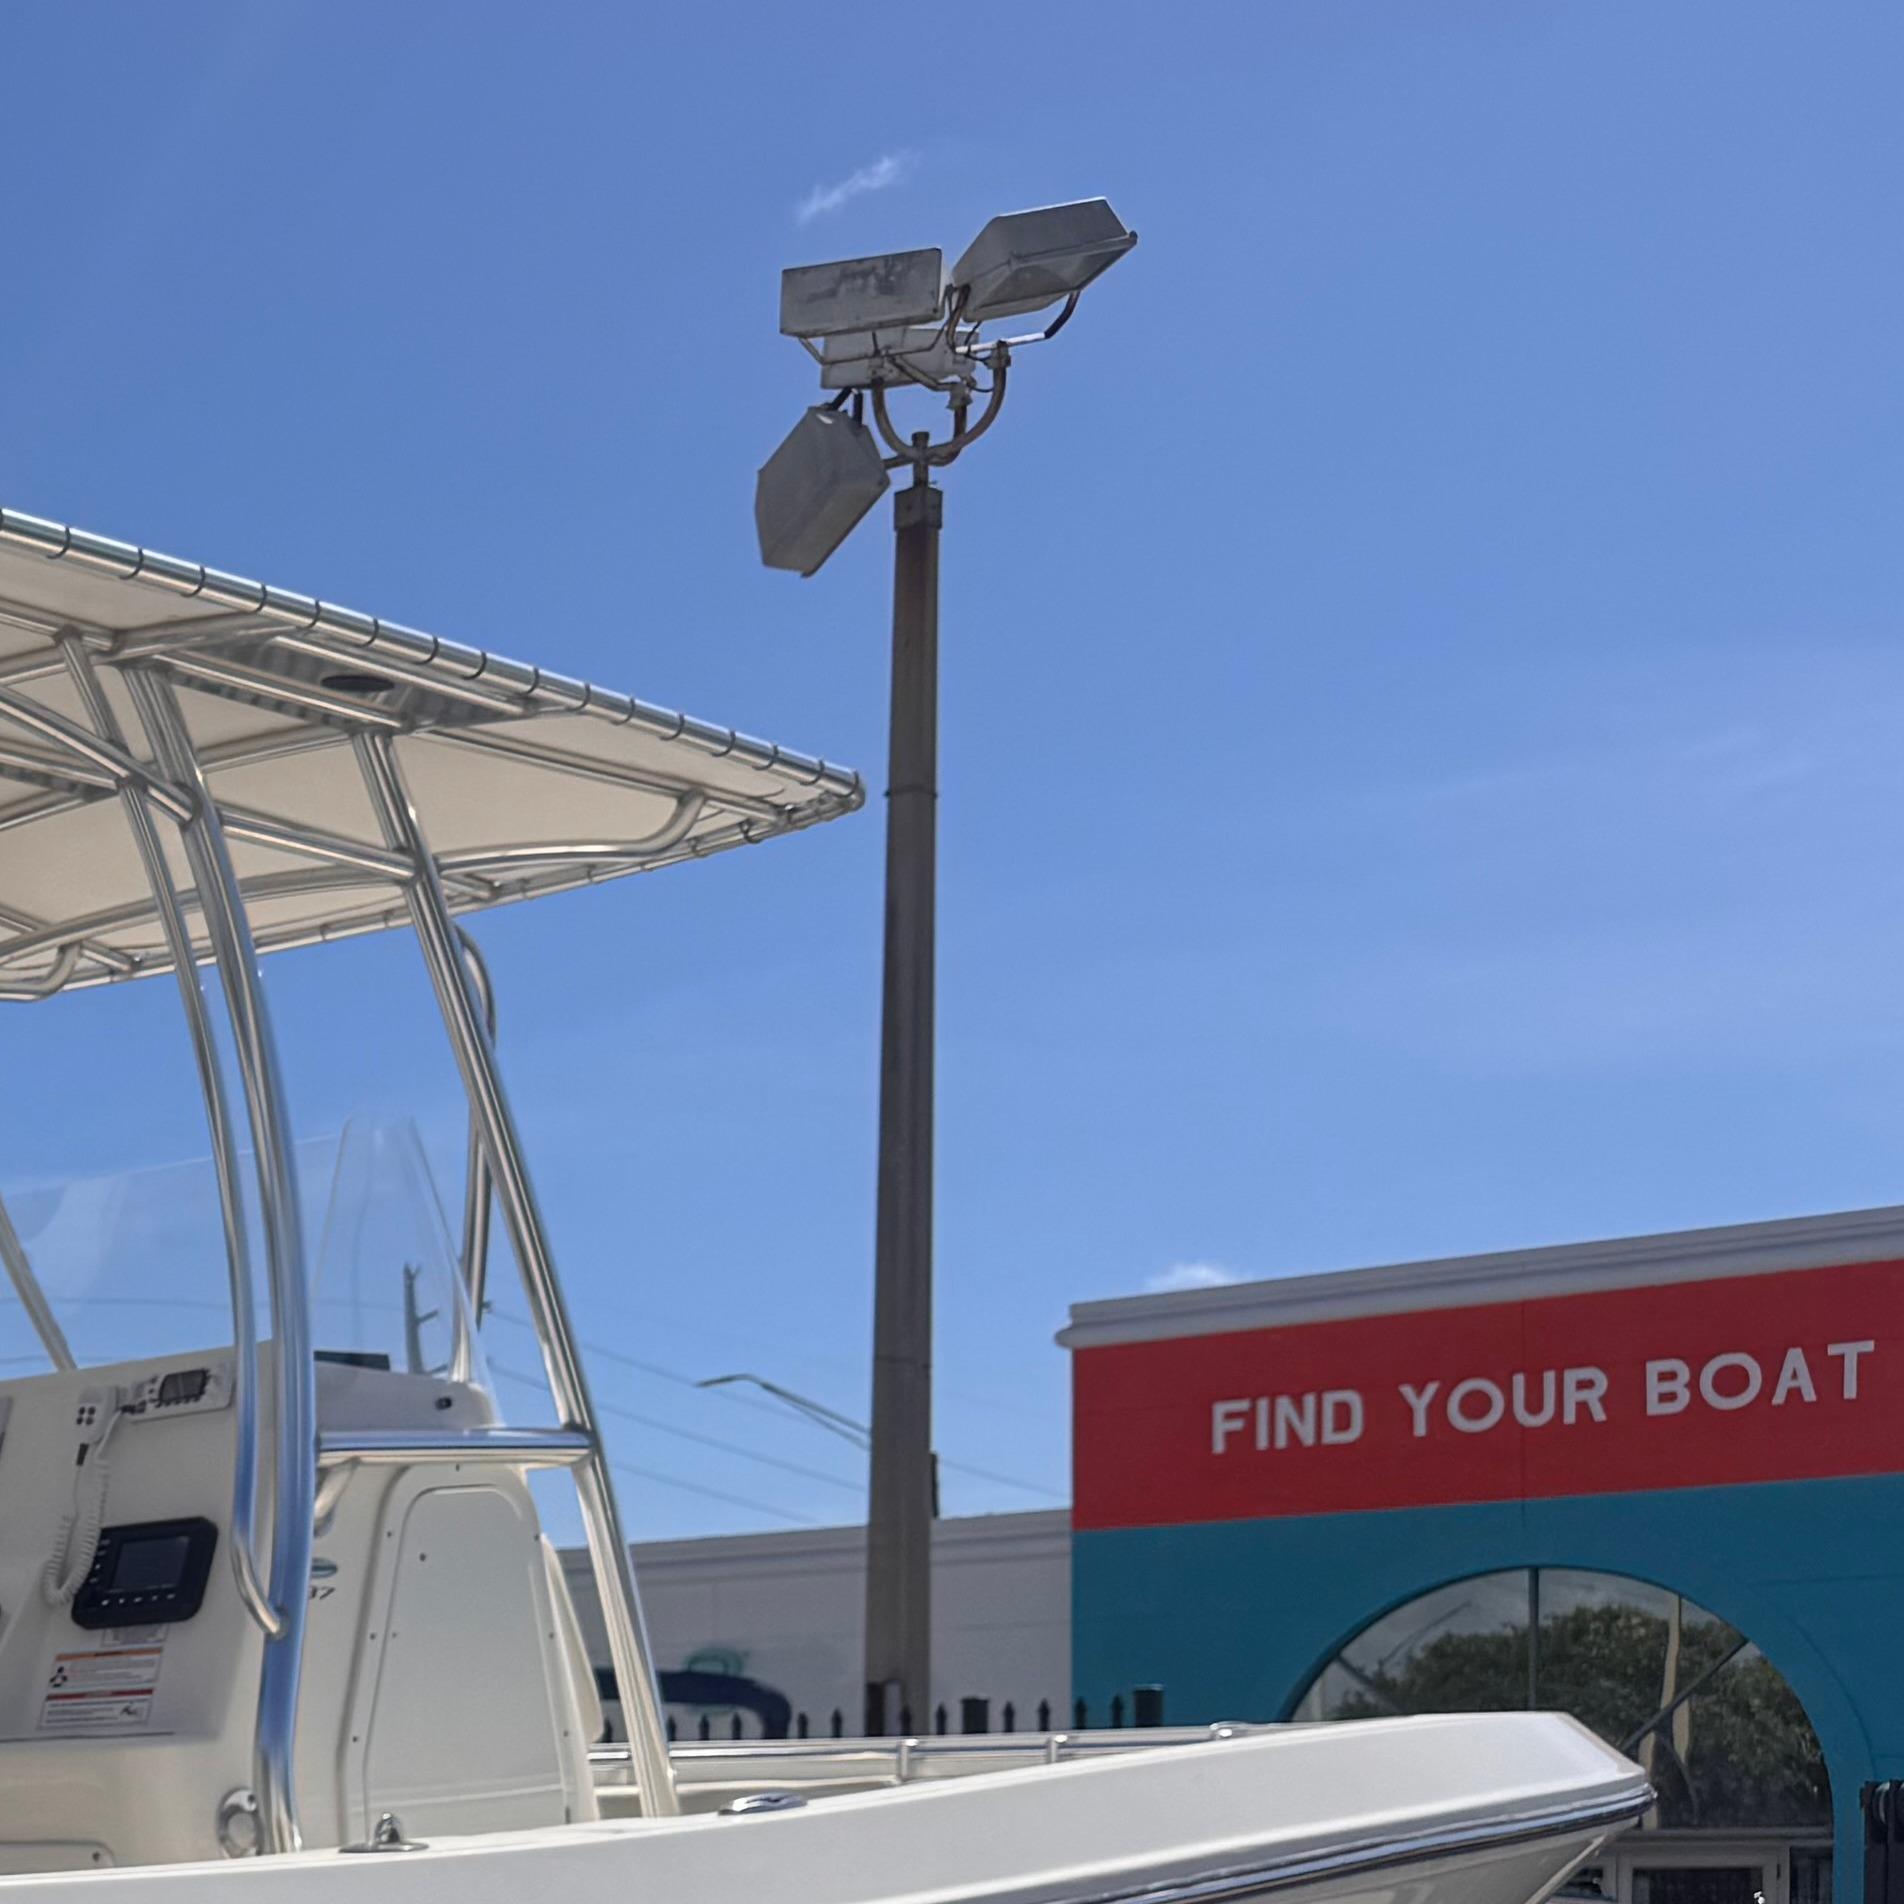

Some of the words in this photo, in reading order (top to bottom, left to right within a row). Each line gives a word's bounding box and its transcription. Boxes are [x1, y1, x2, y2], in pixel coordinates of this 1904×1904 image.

[1212, 1388, 1364, 1455] FIND
[1398, 1366, 1609, 1439] YOUR
[1644, 1339, 1876, 1418] BOAT
